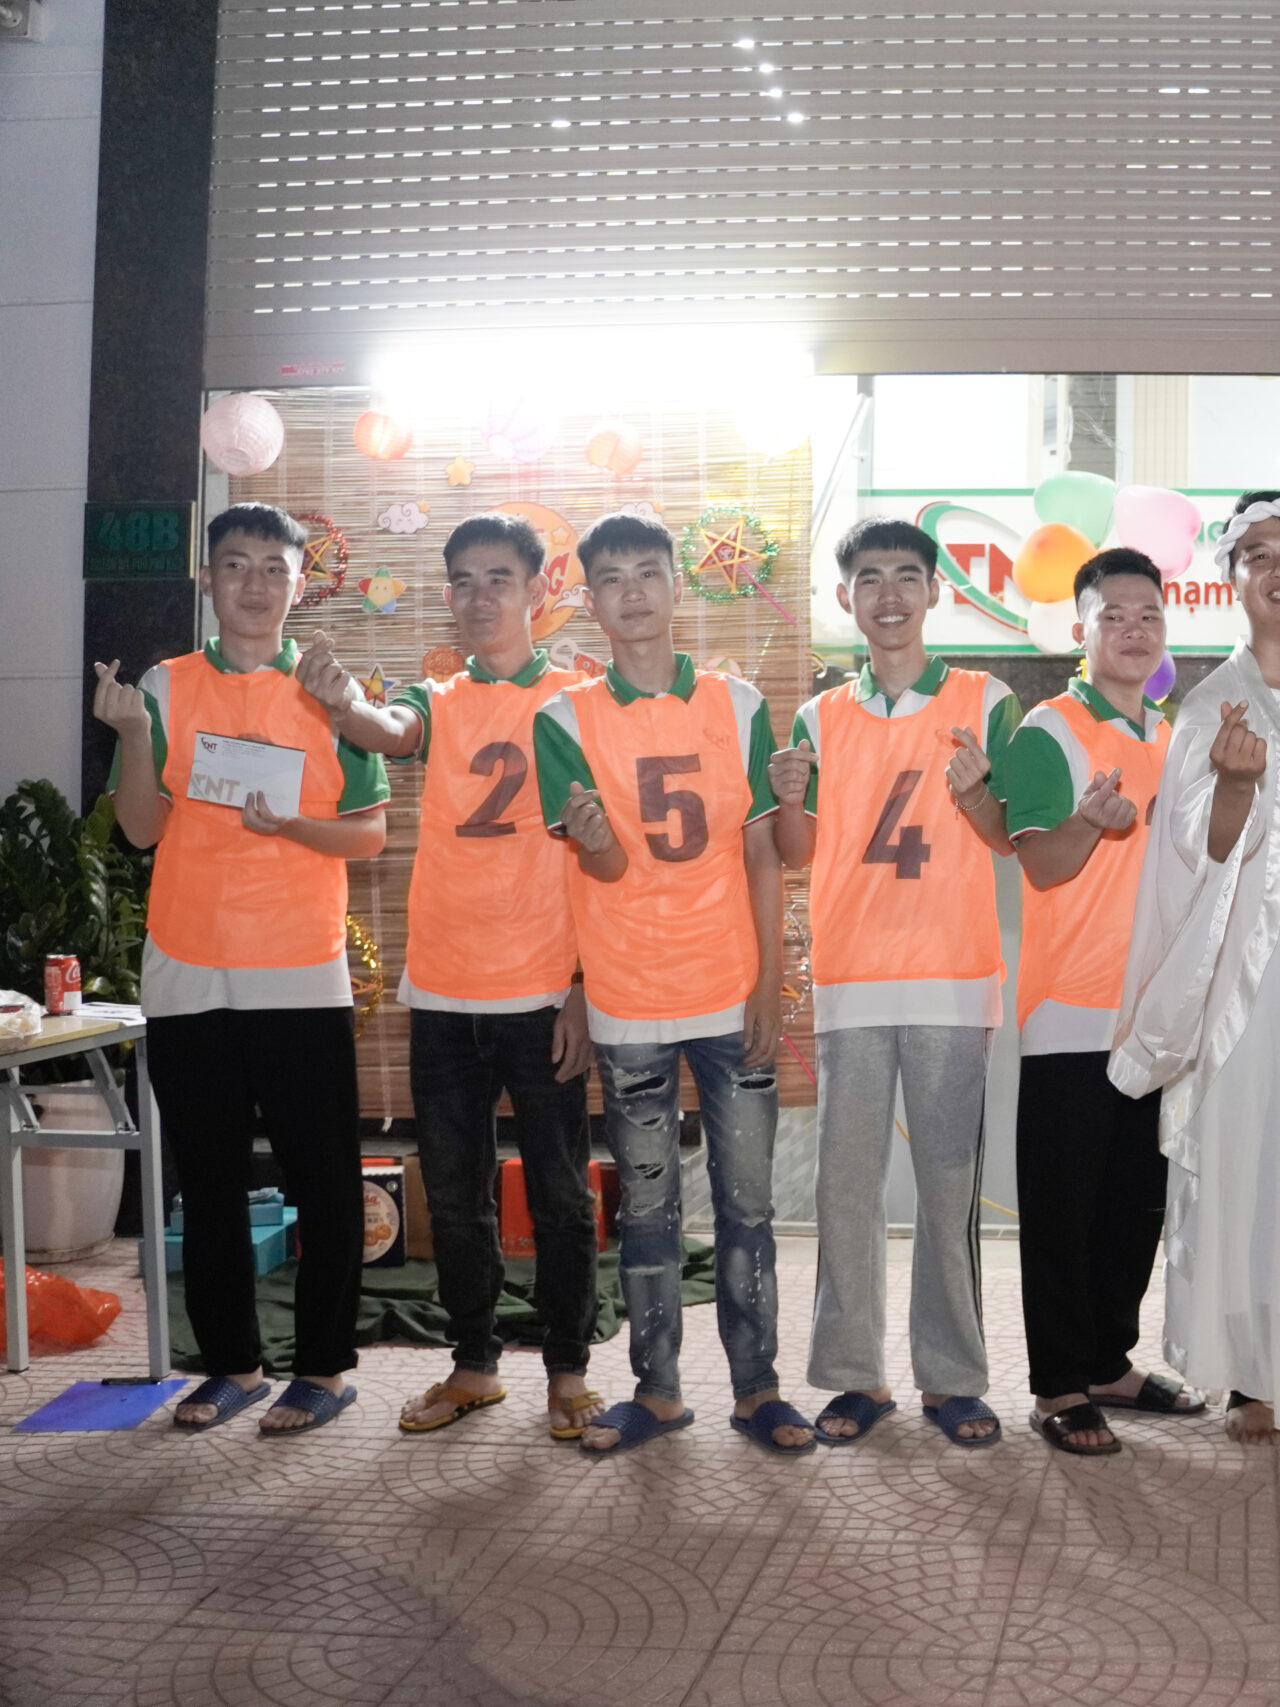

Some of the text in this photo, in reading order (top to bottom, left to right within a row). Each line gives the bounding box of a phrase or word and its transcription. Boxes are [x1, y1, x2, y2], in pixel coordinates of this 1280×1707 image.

[944, 543, 1015, 604] TN
[456, 741, 528, 838] 2
[636, 754, 709, 862] 5
[862, 770, 931, 879] 4
